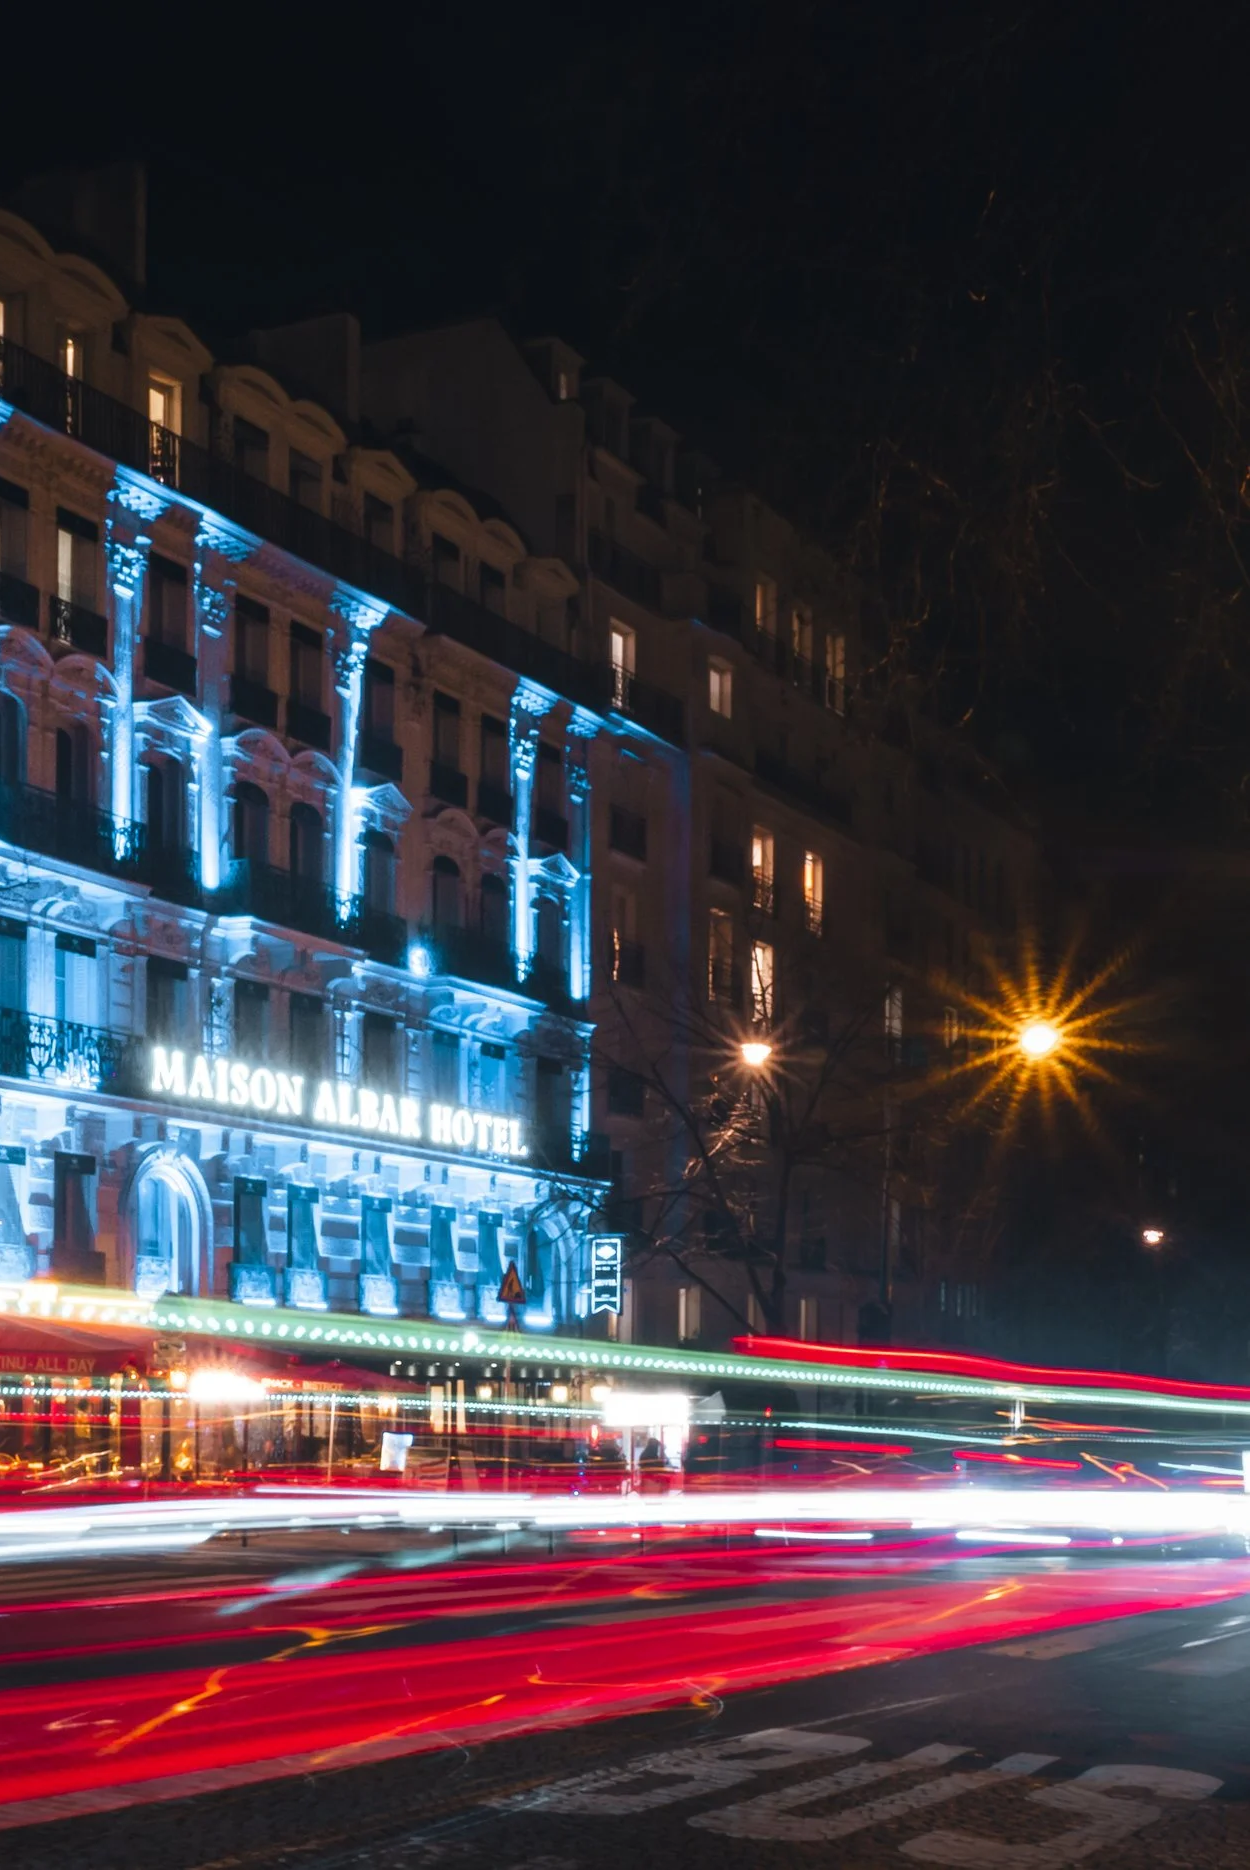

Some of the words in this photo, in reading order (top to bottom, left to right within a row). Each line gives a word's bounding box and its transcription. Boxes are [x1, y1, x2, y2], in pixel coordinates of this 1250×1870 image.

[151, 1047, 305, 1115] MAISON
[314, 1081, 422, 1138] ALBAR
[430, 1102, 529, 1156] HOTEL
[67, 1358, 96, 1373] DAY
[482, 1726, 1226, 1869] BUS
